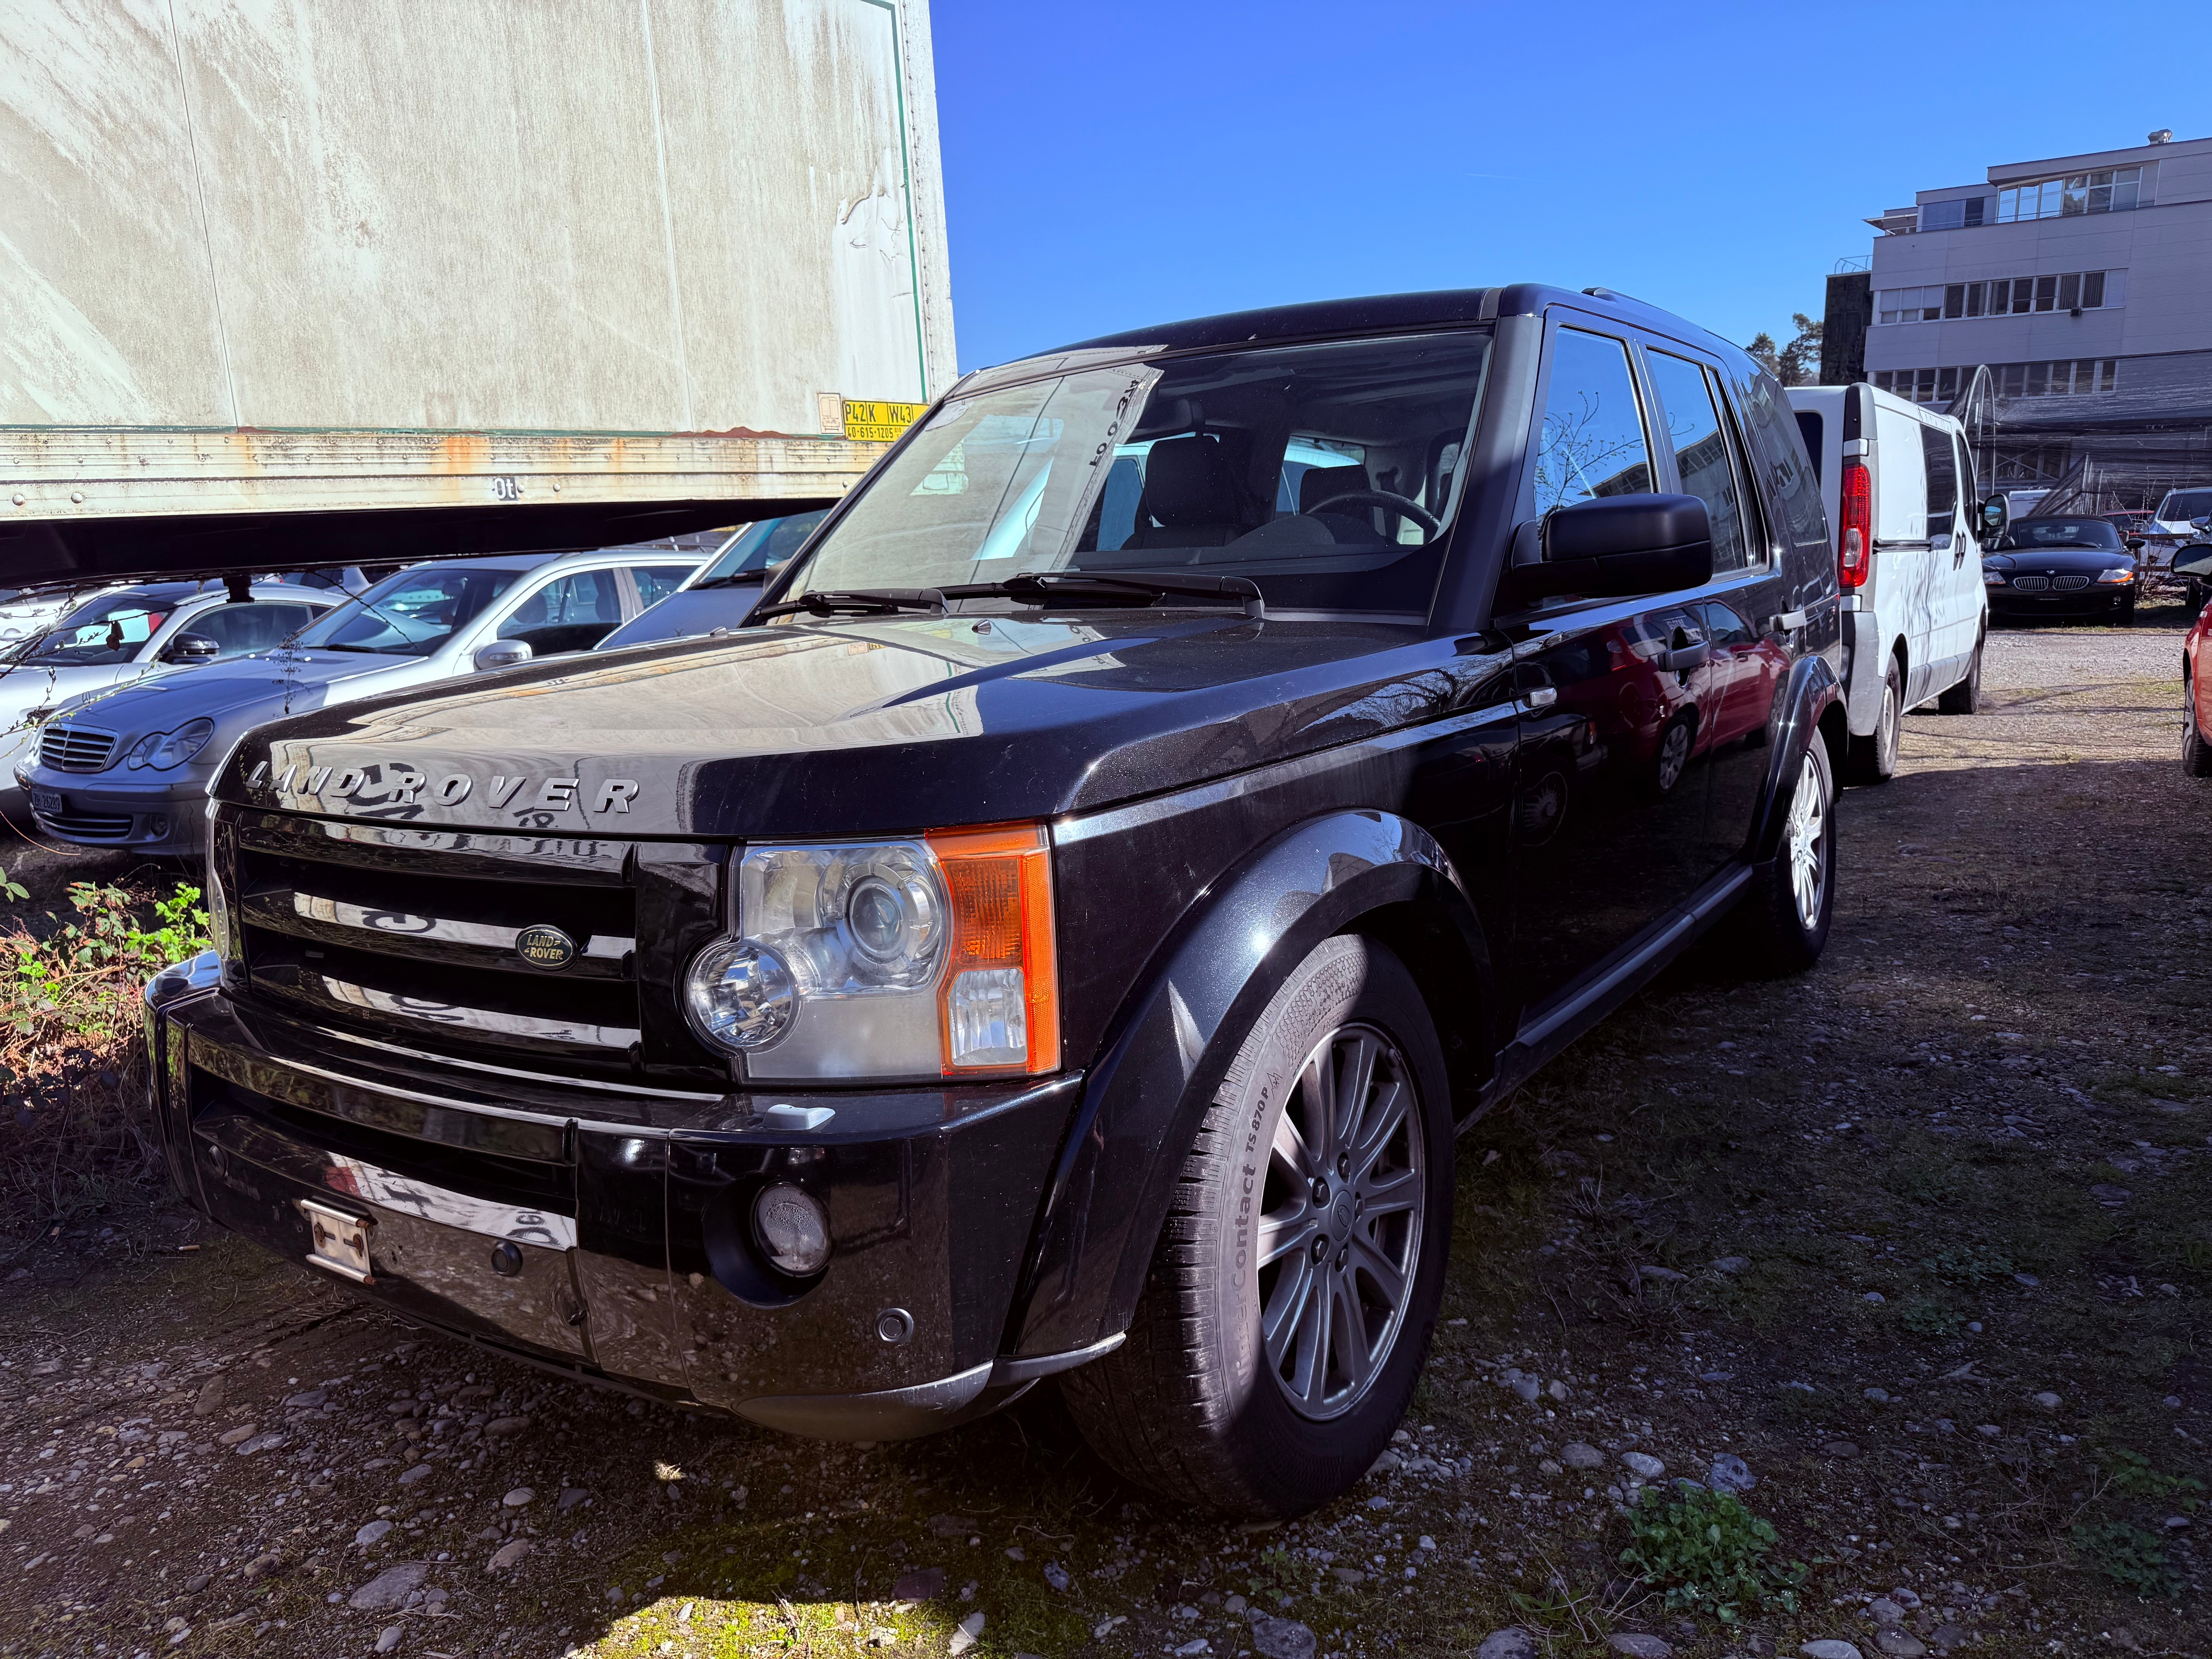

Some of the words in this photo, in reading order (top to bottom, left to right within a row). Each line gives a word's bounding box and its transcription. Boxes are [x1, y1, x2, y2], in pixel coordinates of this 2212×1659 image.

[889, 405, 911, 423] W43
[246, 761, 365, 798] LAND
[388, 771, 639, 814] ROVER
[527, 934, 554, 947] LAND
[530, 947, 563, 960] ROVER
[1245, 1133, 1257, 1152] TS
[1252, 1100, 1265, 1131] 870
[1261, 1087, 1268, 1100] P
